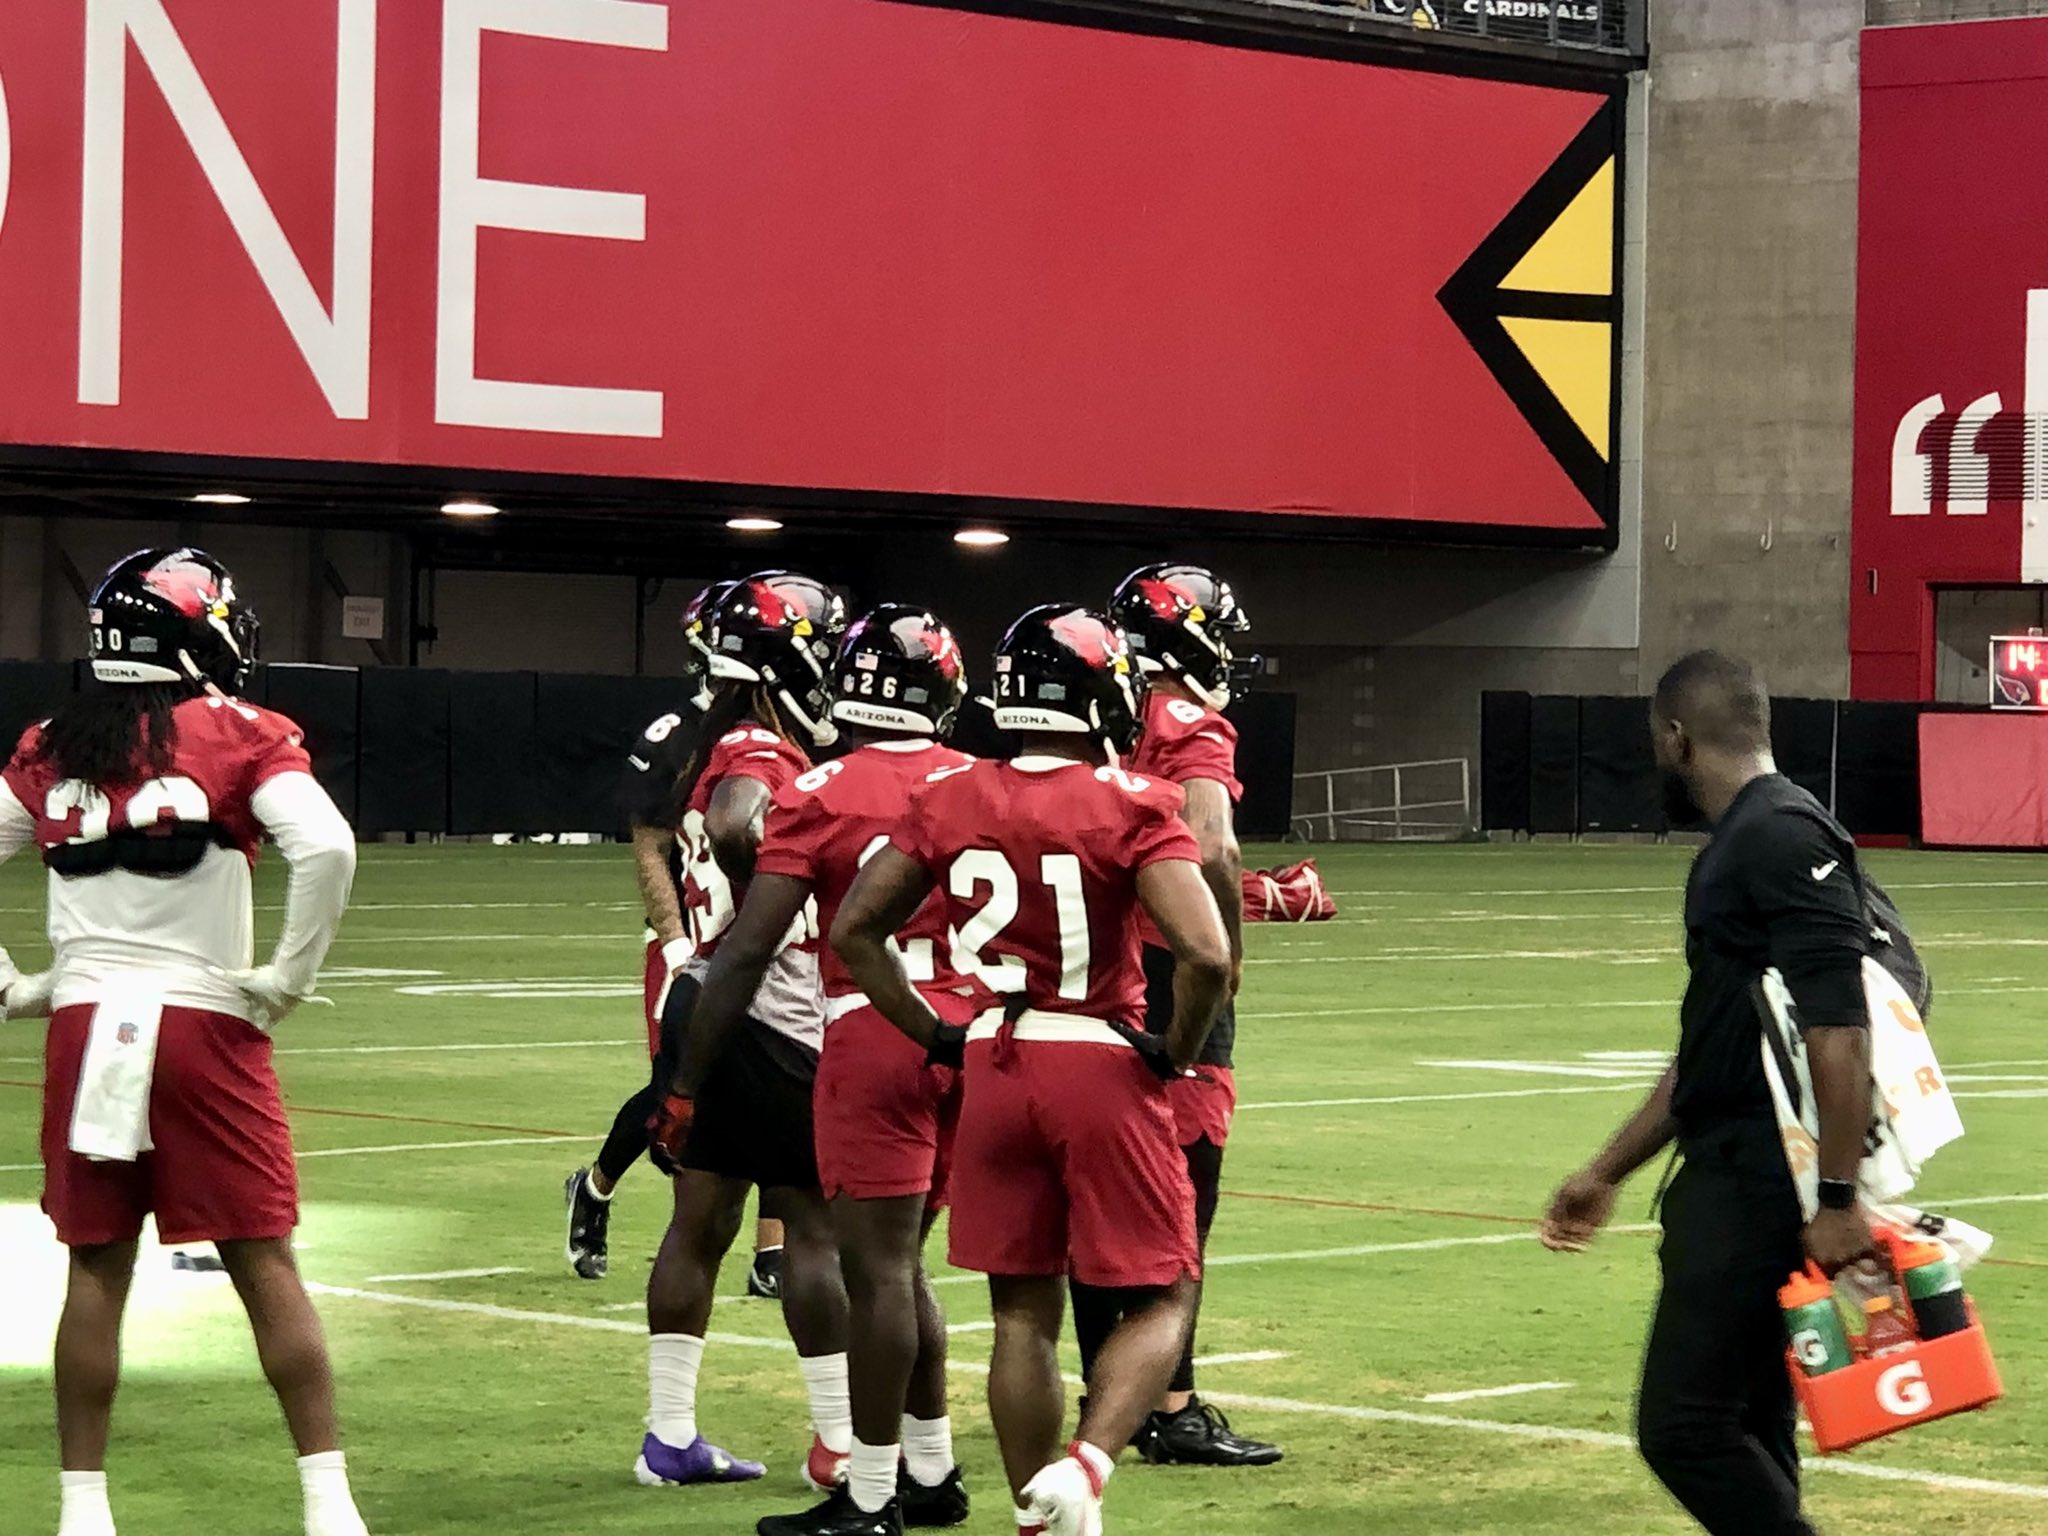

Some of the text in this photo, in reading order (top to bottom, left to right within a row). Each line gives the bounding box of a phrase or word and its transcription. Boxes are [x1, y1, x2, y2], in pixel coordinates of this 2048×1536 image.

[0, 0, 669, 438] NE
[860, 672, 897, 699] 26
[1000, 674, 1025, 697] 21
[846, 708, 906, 725] ARIZONA
[794, 760, 845, 792] 6
[1093, 766, 1151, 793] 2
[949, 848, 1091, 1001] 21
[1792, 1328, 1829, 1366] G
[1875, 1360, 1933, 1416] G
